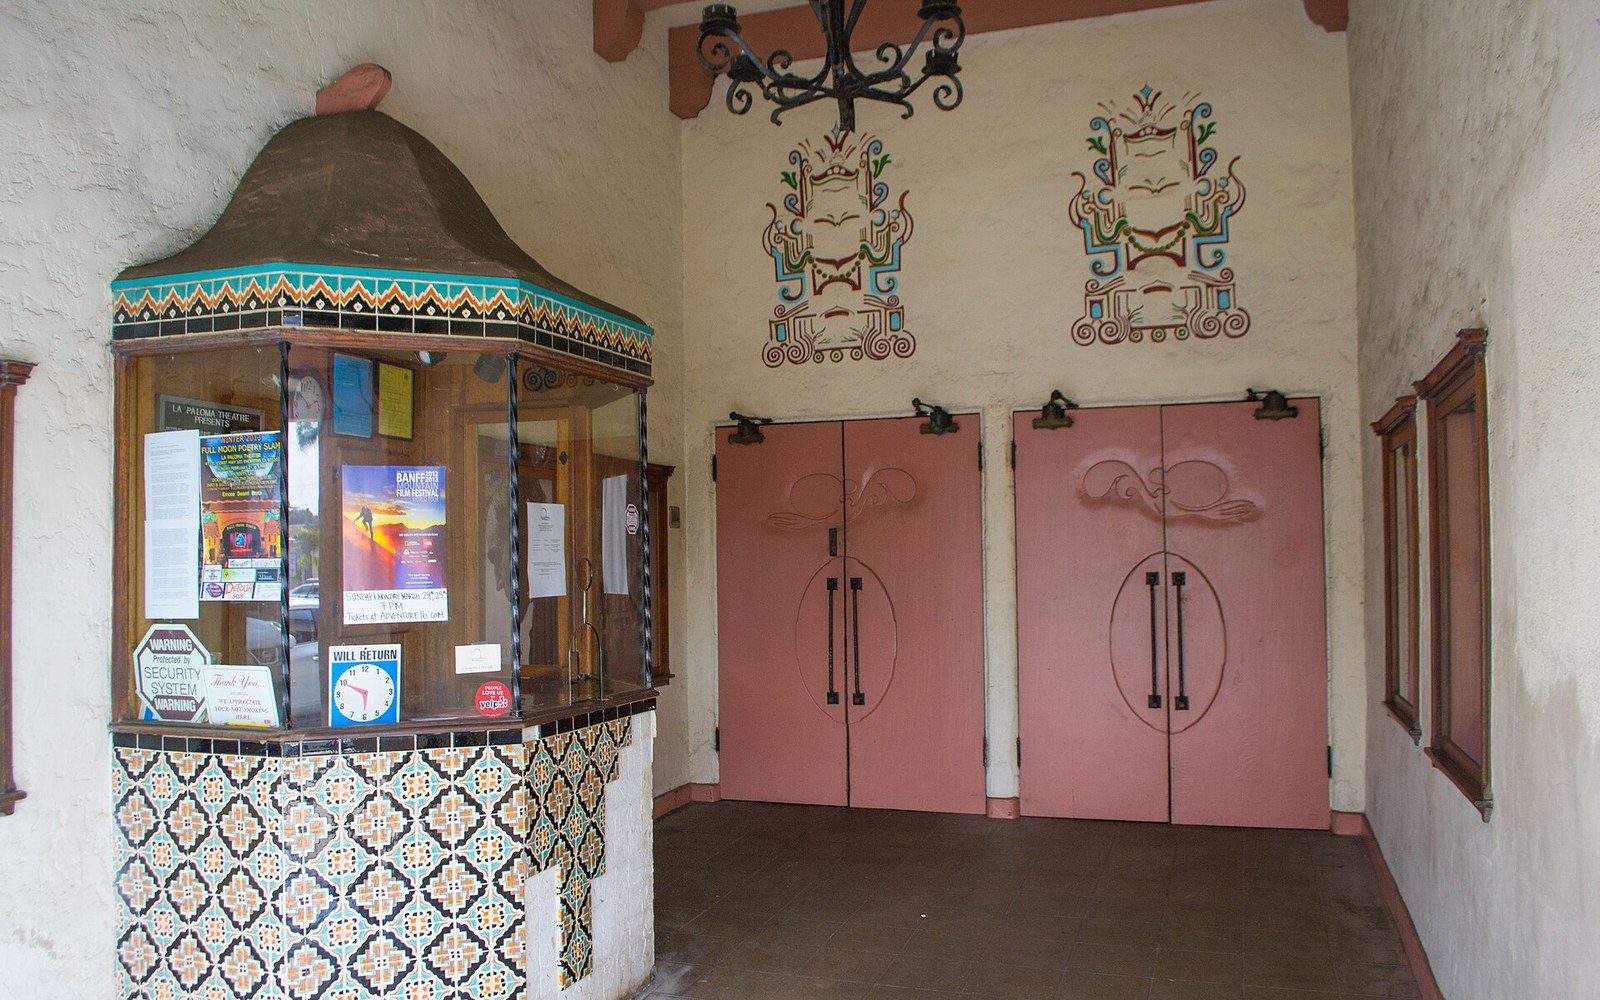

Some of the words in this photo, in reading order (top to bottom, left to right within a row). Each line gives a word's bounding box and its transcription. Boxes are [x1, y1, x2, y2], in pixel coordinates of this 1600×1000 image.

[172, 404, 182, 413] LA
[186, 406, 215, 417] PALOMA
[218, 411, 250, 422] THEATRE
[194, 416, 230, 428] PRESENTS
[220, 435, 244, 443] WINTER
[218, 445, 237, 453] MOON
[263, 442, 281, 450] SLAM
[397, 472, 425, 482] BANFF
[346, 592, 372, 601] SUNDAY
[380, 602, 386, 610] 7
[347, 612, 368, 621] Tickets
[371, 612, 377, 621] at
[150, 639, 192, 651] WARNING
[153, 655, 180, 663] Protected
[183, 656, 191, 665] by
[334, 651, 356, 661] WILL
[360, 650, 397, 660] RETURN
[144, 666, 200, 680] SECURITY
[211, 674, 236, 686] Thank
[151, 682, 197, 695] SYSTEM
[154, 698, 196, 712] WARNING
[479, 699, 500, 710] yelp
